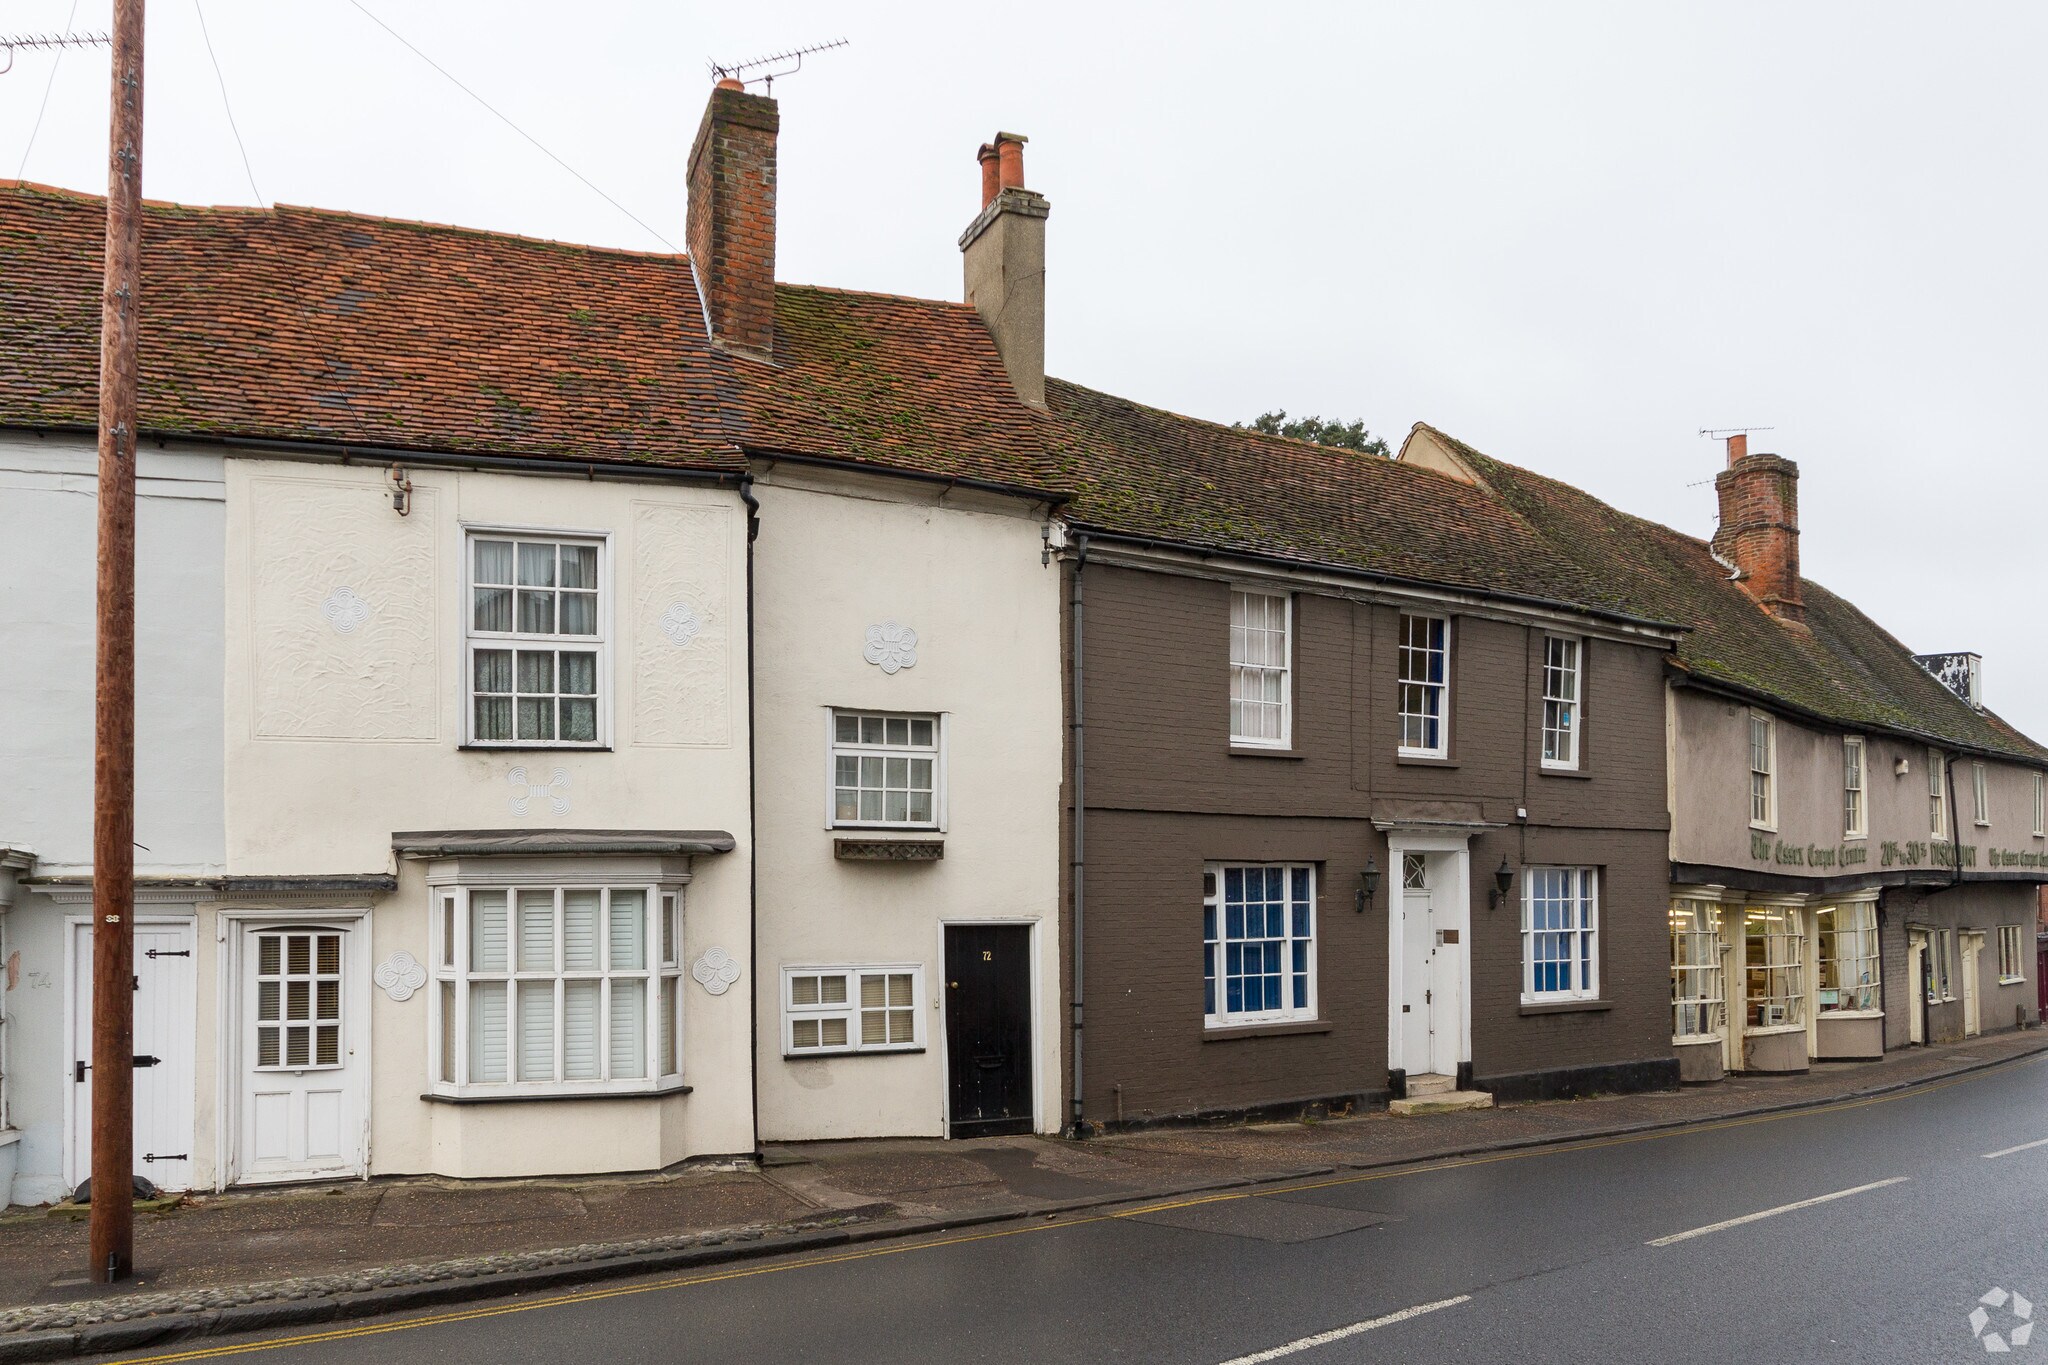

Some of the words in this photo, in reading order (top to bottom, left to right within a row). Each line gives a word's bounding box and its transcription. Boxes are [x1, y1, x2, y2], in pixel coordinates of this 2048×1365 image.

[1776, 840, 1804, 866] Essex
[1808, 842, 1836, 870] Carpet
[982, 951, 991, 961] 72
